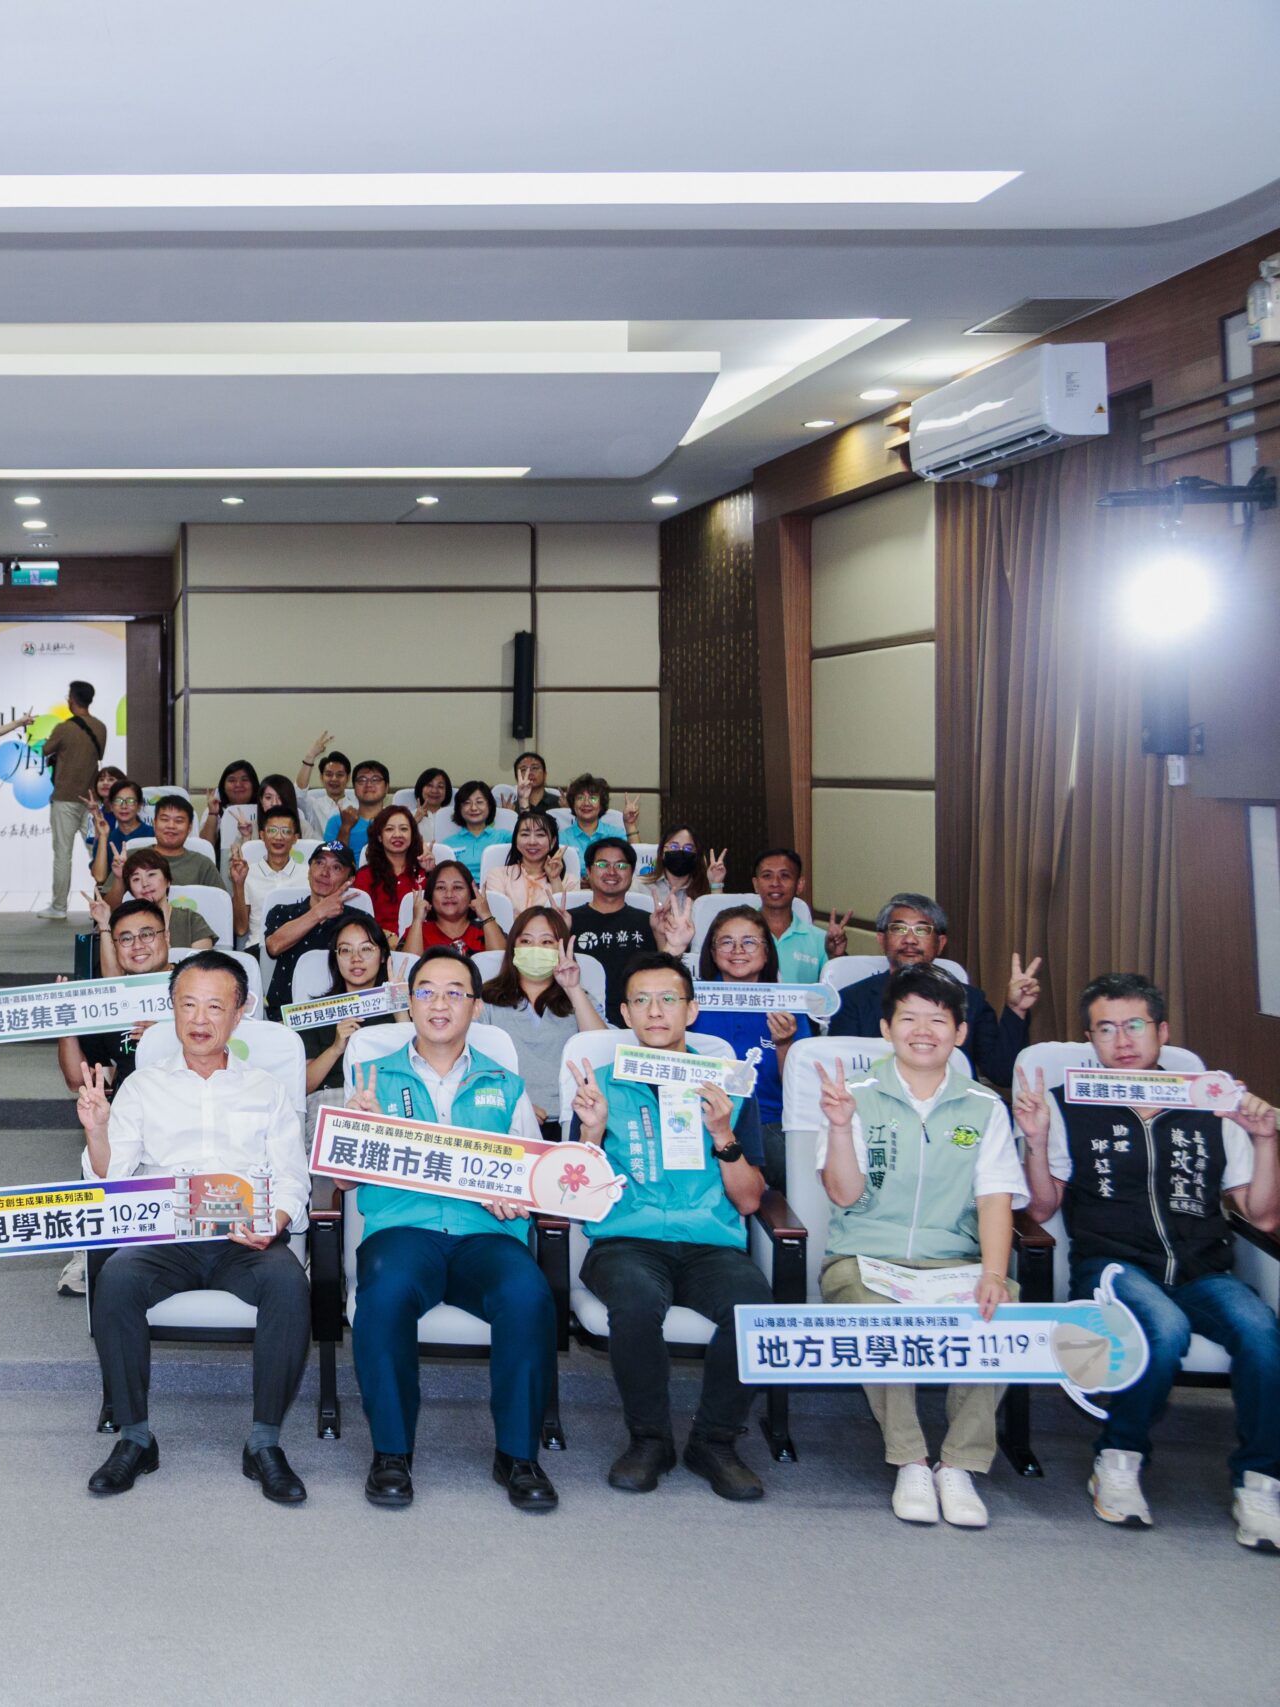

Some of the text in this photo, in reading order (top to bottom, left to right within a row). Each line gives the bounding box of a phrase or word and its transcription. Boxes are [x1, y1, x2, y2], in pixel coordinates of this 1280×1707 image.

[81, 1002, 119, 1019] 10/15
[694, 993, 775, 1008] 地方見學旅行
[289, 1002, 361, 1027] 地方見學旅行
[623, 1059, 687, 1082] 舞台活動
[1075, 1081, 1146, 1100] 展攤市集
[332, 1118, 513, 1156] 山海嘉境-嘉義縣地方創生成果展系列活動
[328, 1135, 453, 1184] 展攤市集
[460, 1156, 512, 1180] 10/29
[109, 1202, 161, 1223] 10/29
[111, 1223, 157, 1235] 朴子、新港
[753, 1315, 960, 1329] 山海嘉境-嘉義縣地方創生成果展系列活動
[757, 1334, 971, 1369] 地方見學旅行
[978, 1334, 1030, 1354] 11/19
[979, 1357, 1001, 1368] 布袋
